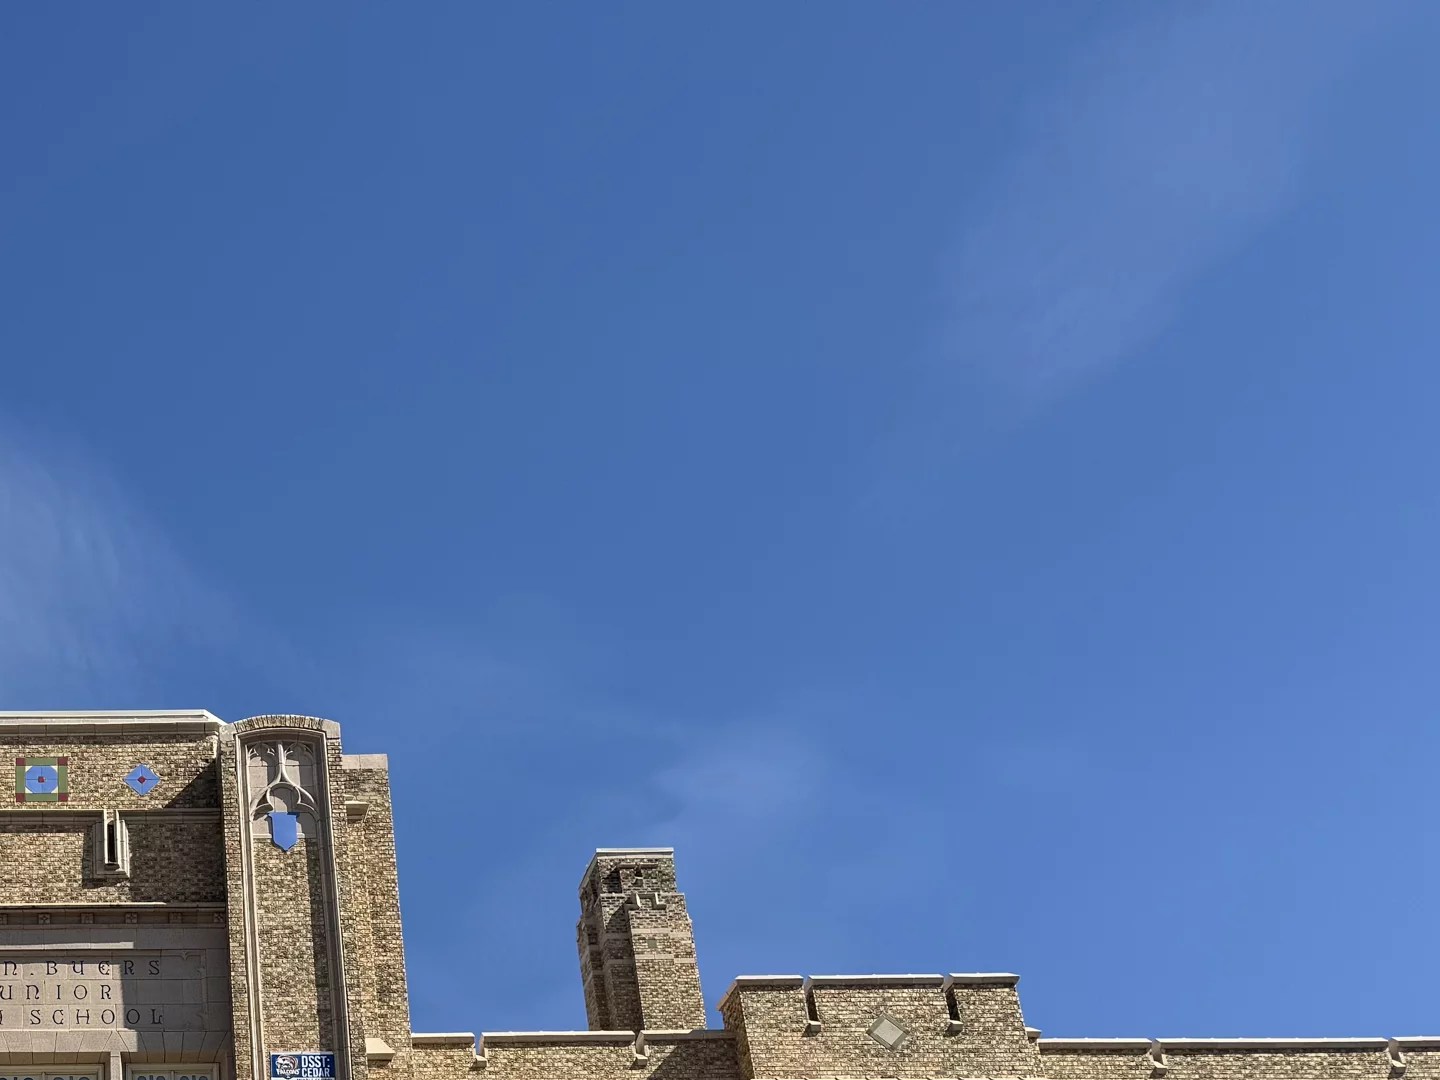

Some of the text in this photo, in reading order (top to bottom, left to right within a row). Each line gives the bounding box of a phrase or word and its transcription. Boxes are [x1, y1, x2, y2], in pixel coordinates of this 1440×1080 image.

[46, 960, 161, 976] BYERS
[29, 1008, 163, 1026] SCHOOL
[301, 1055, 331, 1068] DSST:
[301, 1067, 330, 1078] CEDAR
